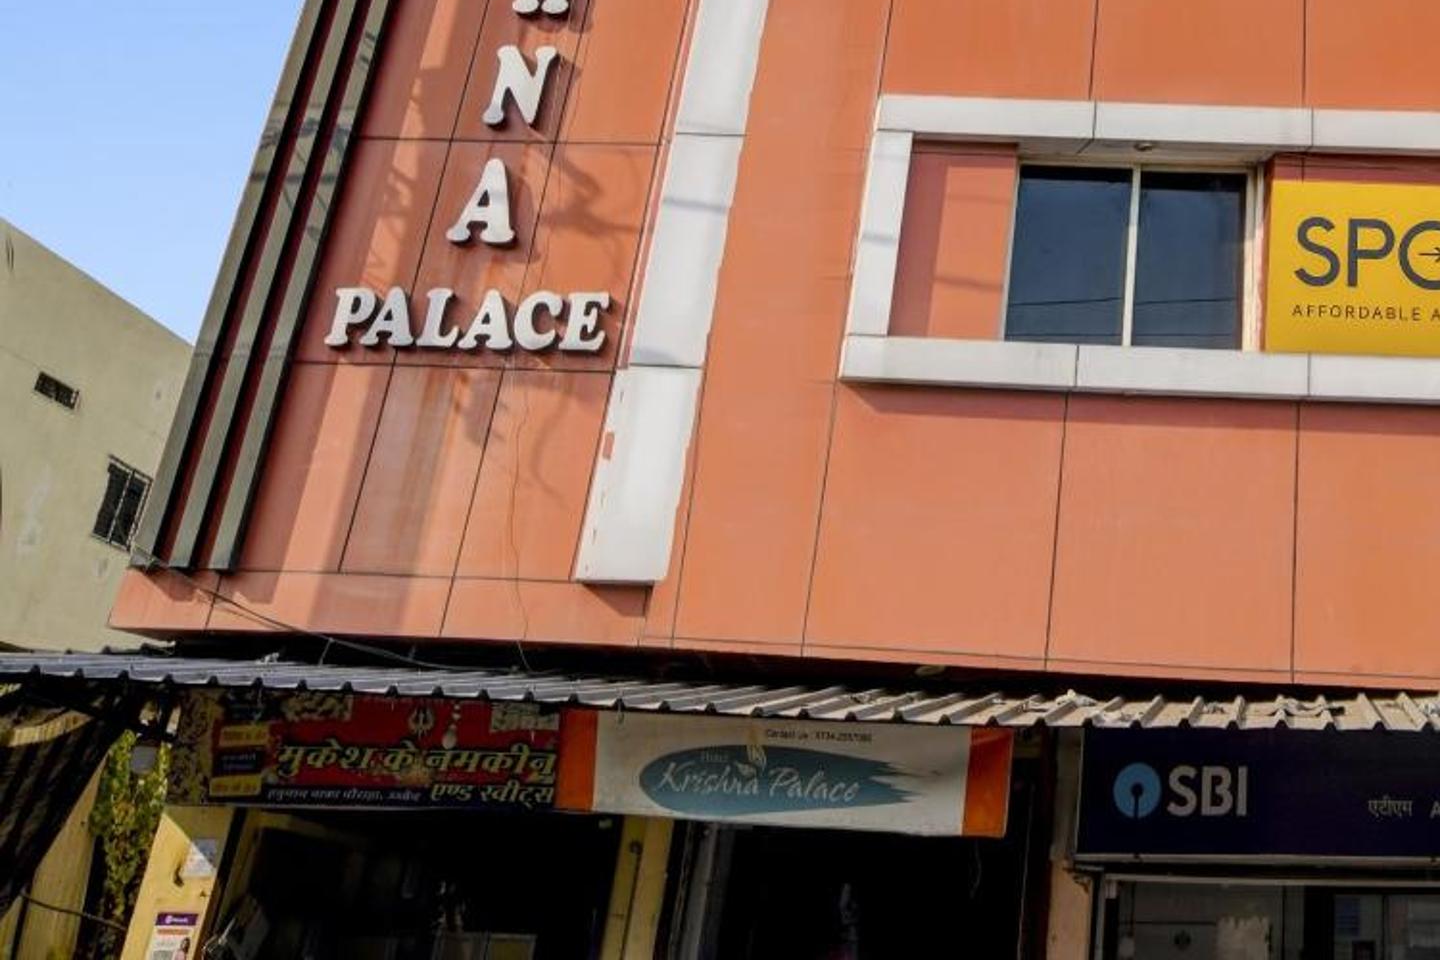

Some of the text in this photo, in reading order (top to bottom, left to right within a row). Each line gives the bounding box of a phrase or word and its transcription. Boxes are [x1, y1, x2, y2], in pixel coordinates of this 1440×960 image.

[324, 286, 611, 351] PALACE
[1292, 304, 1422, 322] AFFORDABLE
[658, 760, 861, 804] Krishna Palace
[1166, 765, 1248, 817] SBI
[1367, 795, 1413, 818] एटीएम
